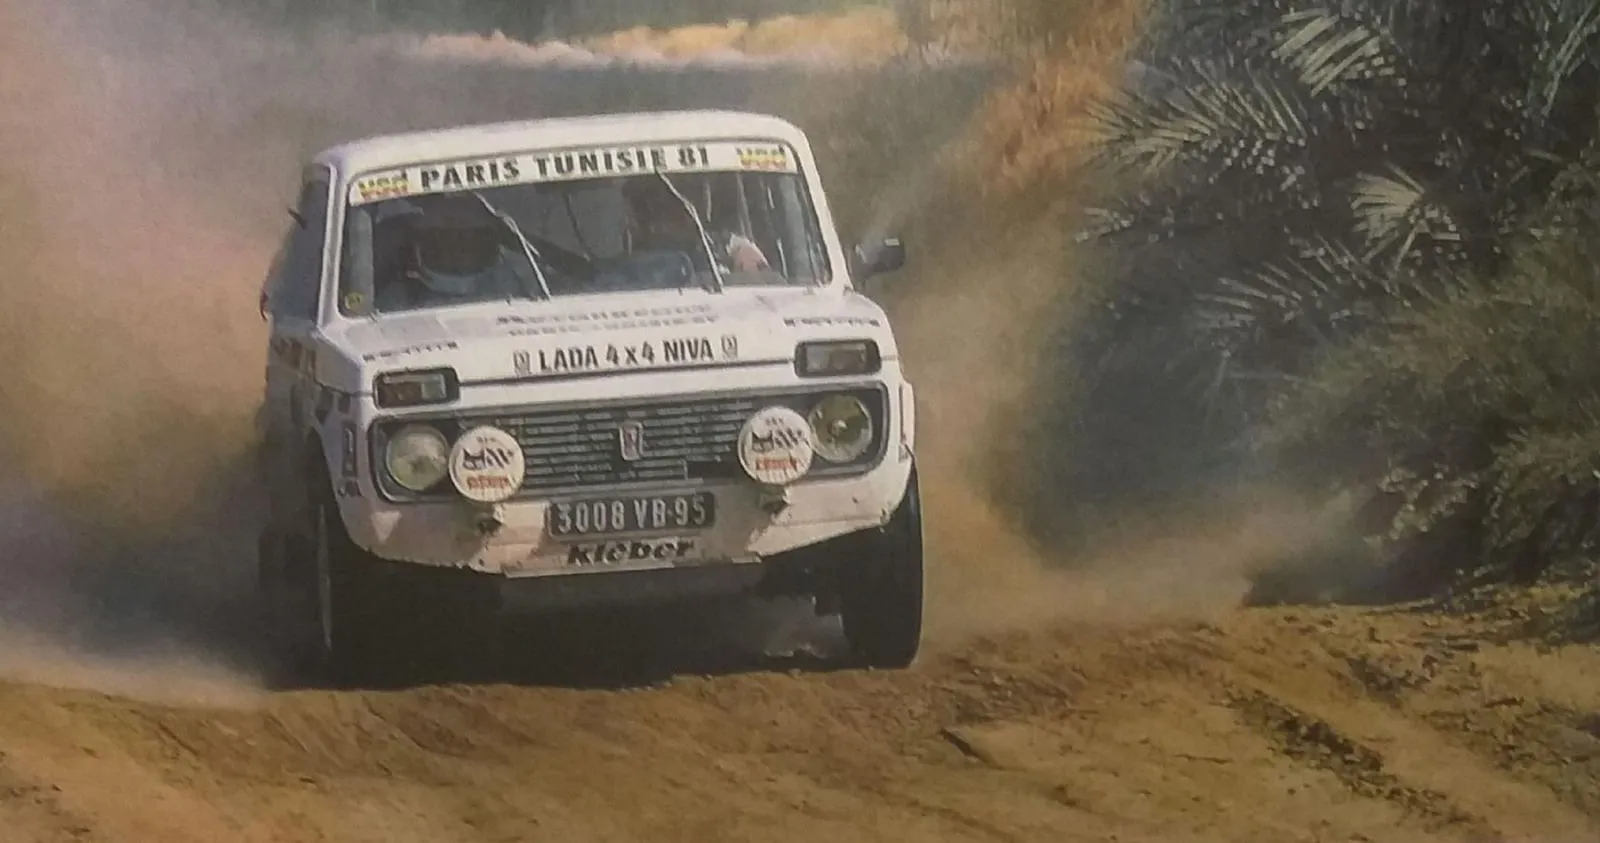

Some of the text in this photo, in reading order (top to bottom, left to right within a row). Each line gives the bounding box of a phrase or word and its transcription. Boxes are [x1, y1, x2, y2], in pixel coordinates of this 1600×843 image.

[420, 146, 710, 188] PARIS TUNISIE 81
[539, 346, 600, 372] LADA
[662, 336, 714, 362] NIVA
[557, 500, 626, 534] 3008
